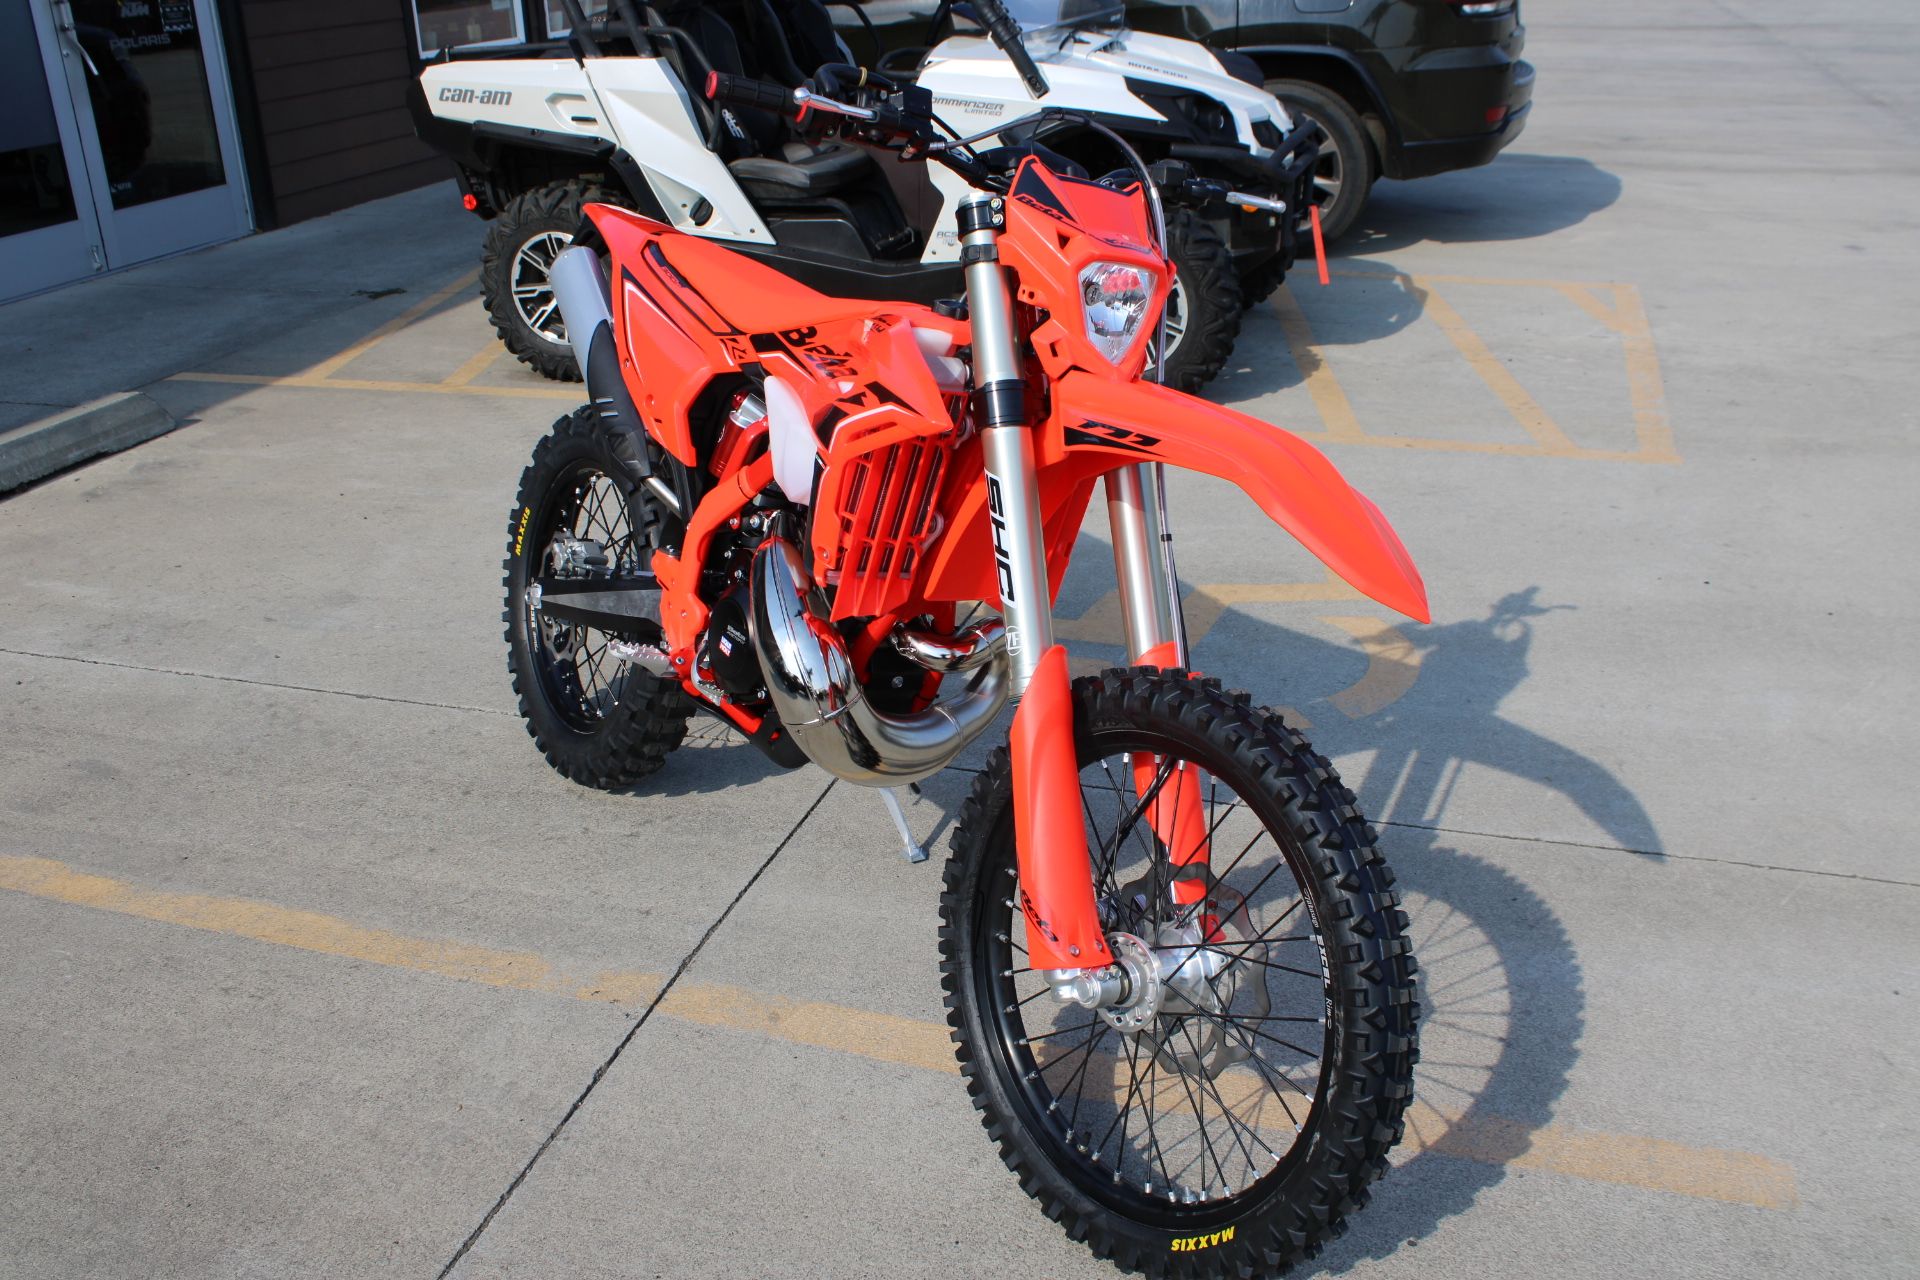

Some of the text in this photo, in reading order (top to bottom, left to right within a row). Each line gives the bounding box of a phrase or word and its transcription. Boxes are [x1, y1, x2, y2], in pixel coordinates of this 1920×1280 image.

[110, 33, 171, 50] POLARIS
[439, 87, 513, 106] can-am
[932, 97, 1005, 111] OMMANDER
[964, 108, 1002, 117] LIMITED
[1015, 195, 1064, 221] Beta
[515, 506, 531, 557] MAXXIS
[985, 473, 1016, 602] SHC
[1316, 934, 1331, 989] EXCEL
[1170, 1225, 1236, 1252] MAXXIS
